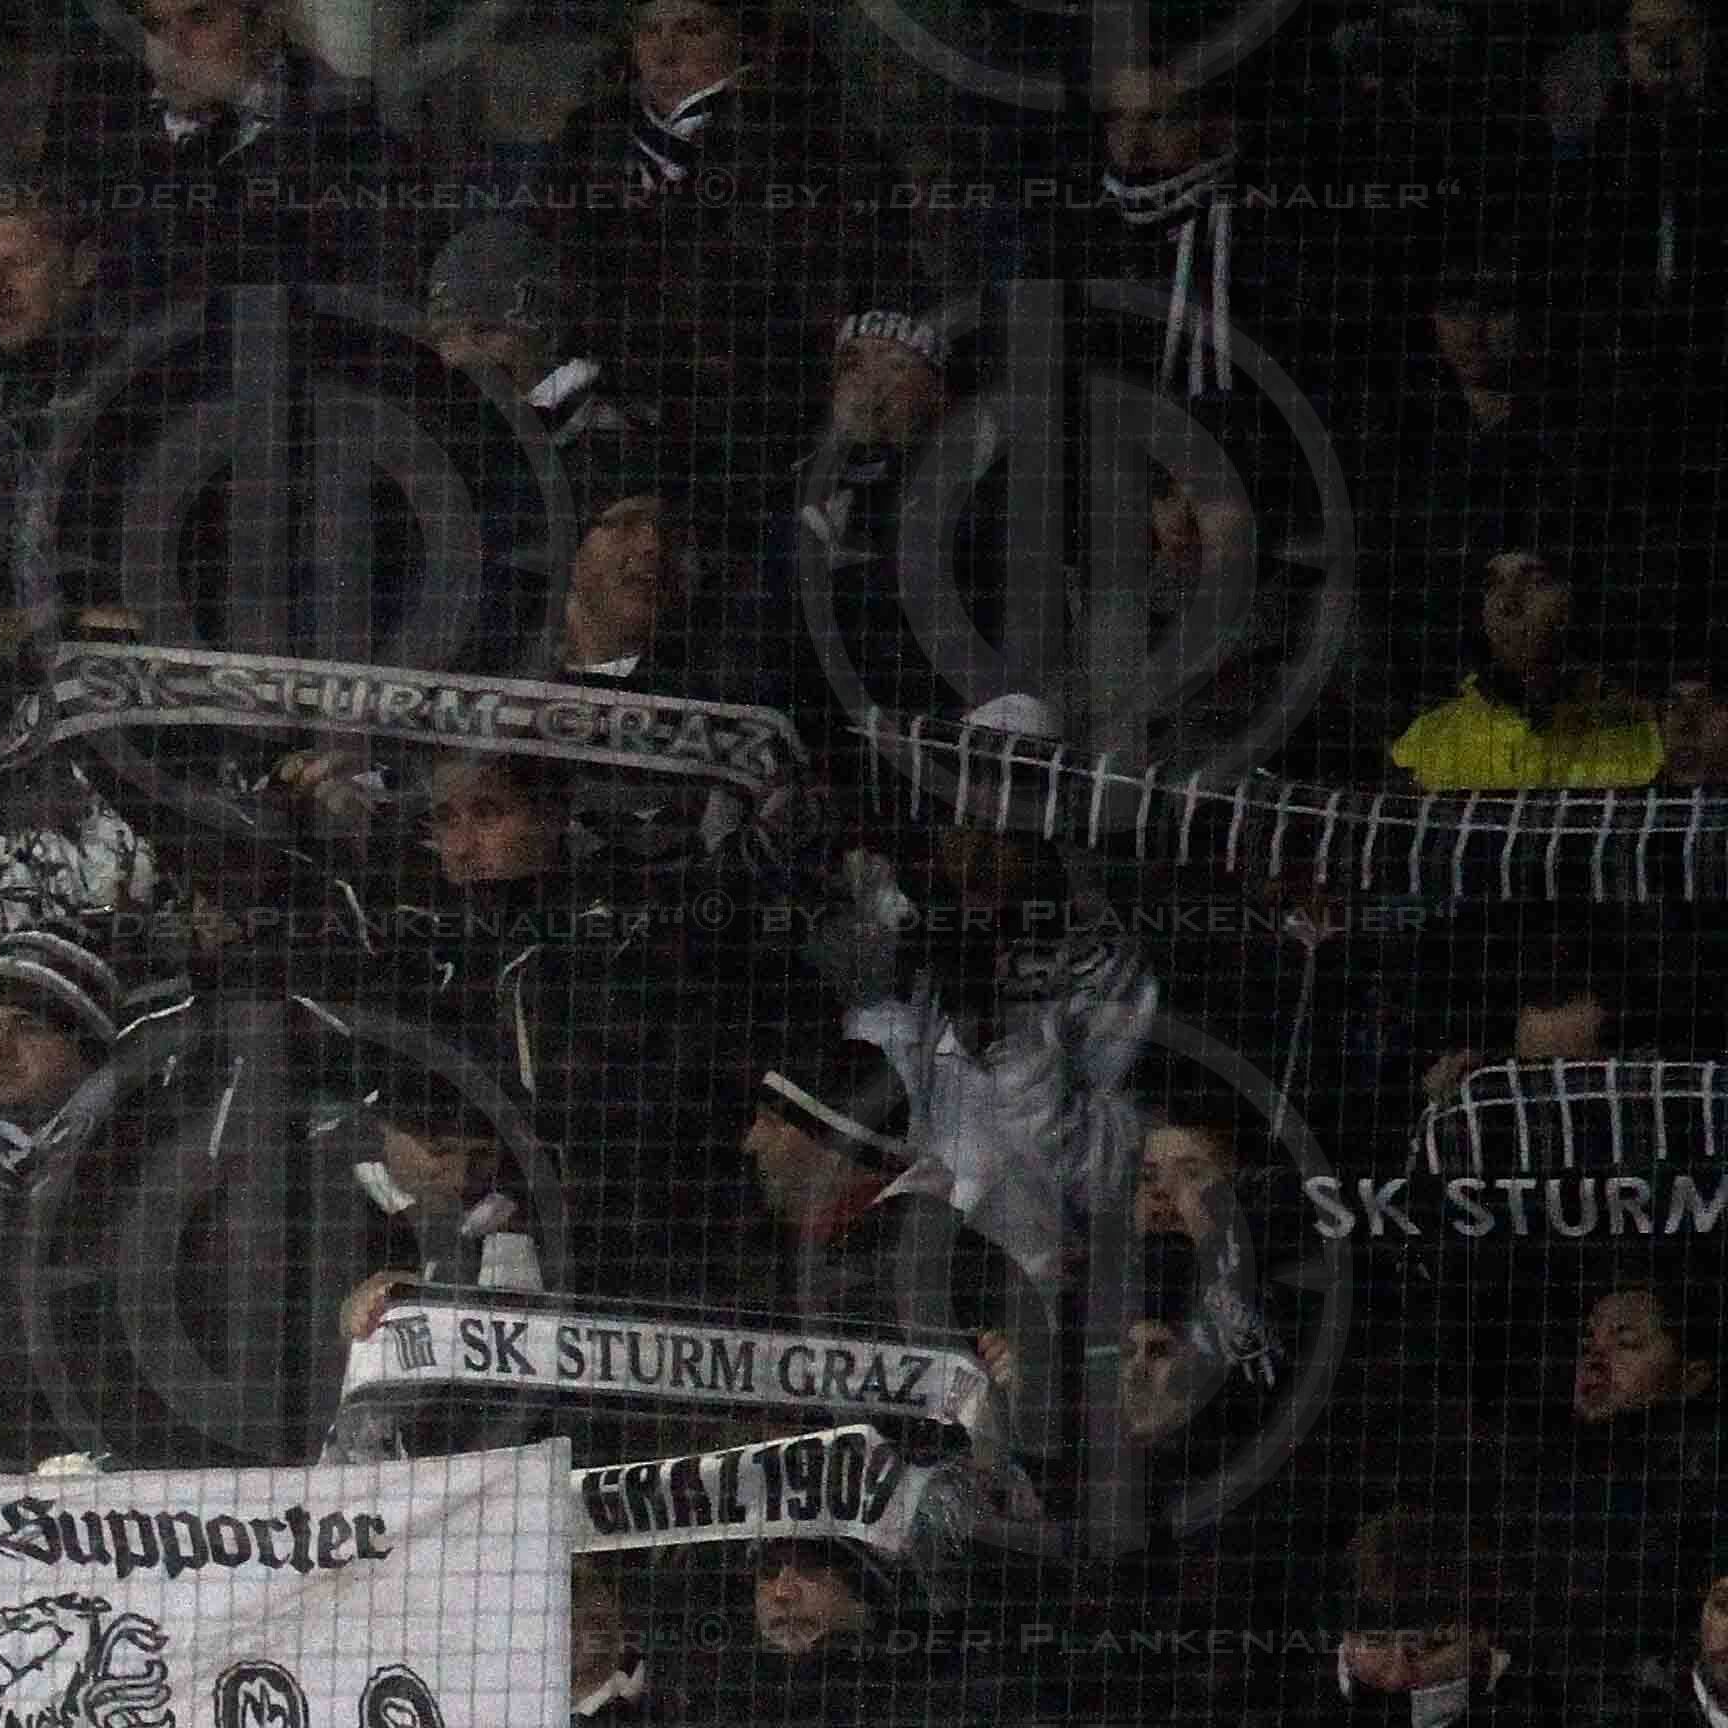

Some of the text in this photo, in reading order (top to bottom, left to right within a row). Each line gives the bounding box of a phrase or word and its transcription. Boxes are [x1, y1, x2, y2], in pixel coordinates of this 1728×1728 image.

[1302, 1175, 1422, 1239] SK
[462, 1318, 933, 1408] SK STURM GRAZ
[582, 1446, 748, 1536] GRAZ
